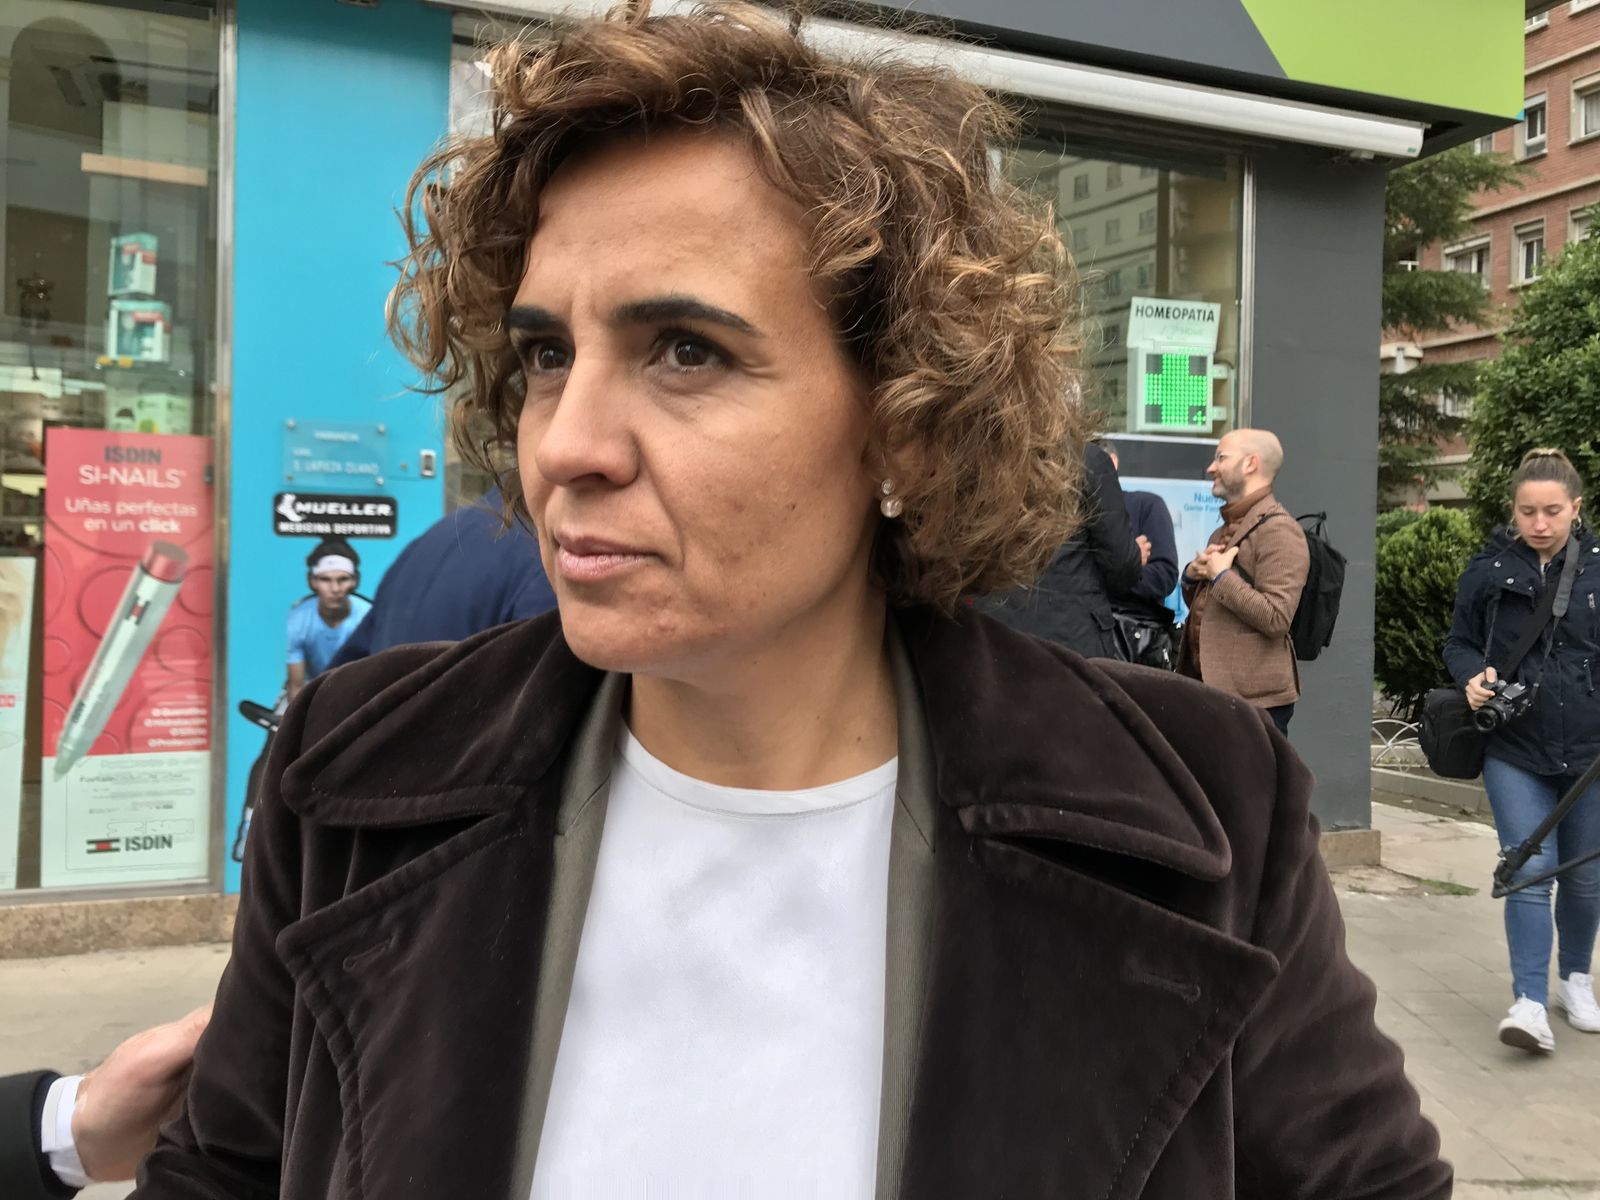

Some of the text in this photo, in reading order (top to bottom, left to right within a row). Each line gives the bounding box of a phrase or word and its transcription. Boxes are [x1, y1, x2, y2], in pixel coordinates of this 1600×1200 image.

[1135, 305, 1215, 322] HOMEOPATIA
[104, 447, 161, 464] ISDIN
[79, 464, 182, 489] SI-NAILS
[64, 497, 198, 517] Uñas perfectas
[295, 501, 392, 516] MUELLER
[83, 518, 181, 533] en un click
[278, 521, 391, 535] MEDICINA DEPORTIVA
[125, 835, 173, 852] ISDIN
